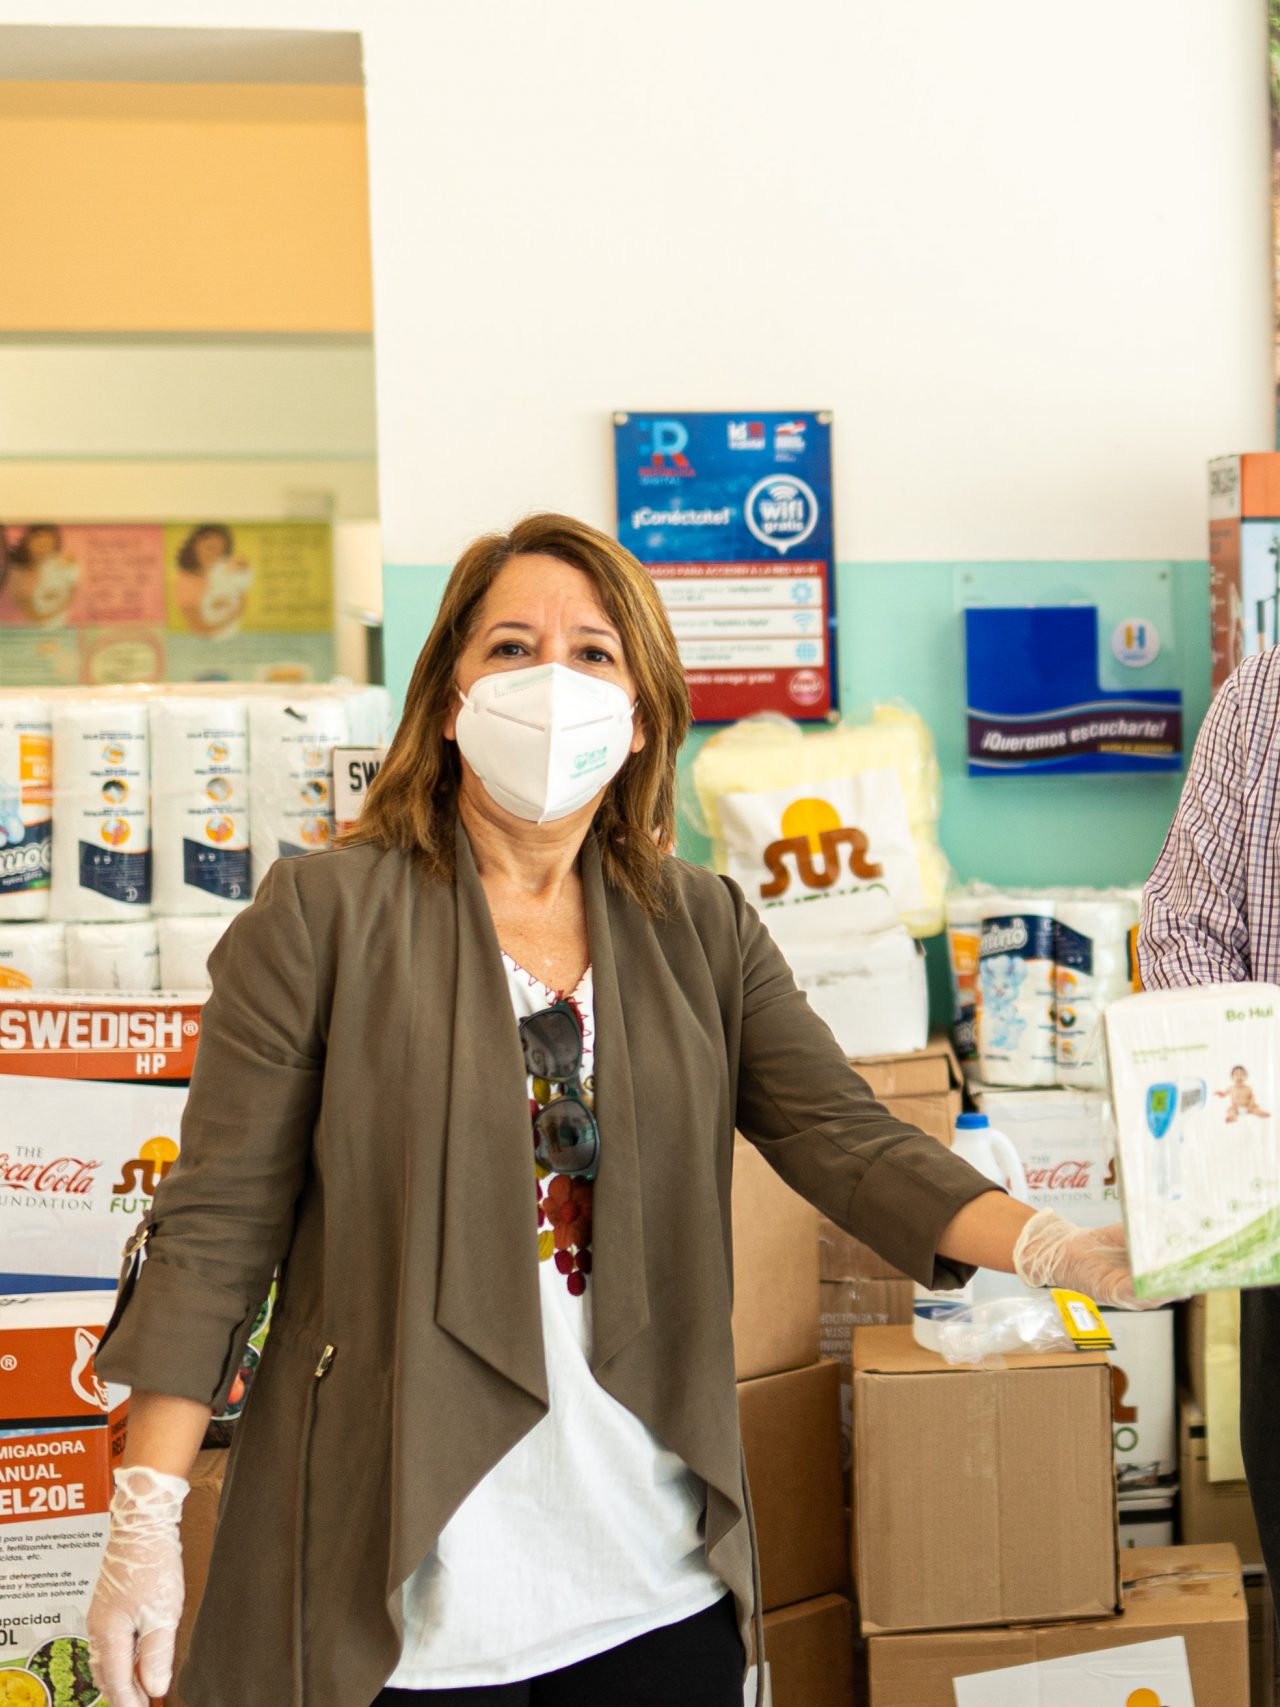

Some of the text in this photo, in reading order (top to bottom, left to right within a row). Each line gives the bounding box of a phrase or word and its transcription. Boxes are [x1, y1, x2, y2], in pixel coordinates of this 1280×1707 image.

[981, 719, 1167, 751] ¡Queremos escucharte!
[136, 1053, 167, 1075] HP
[16, 1146, 46, 1158] THE
